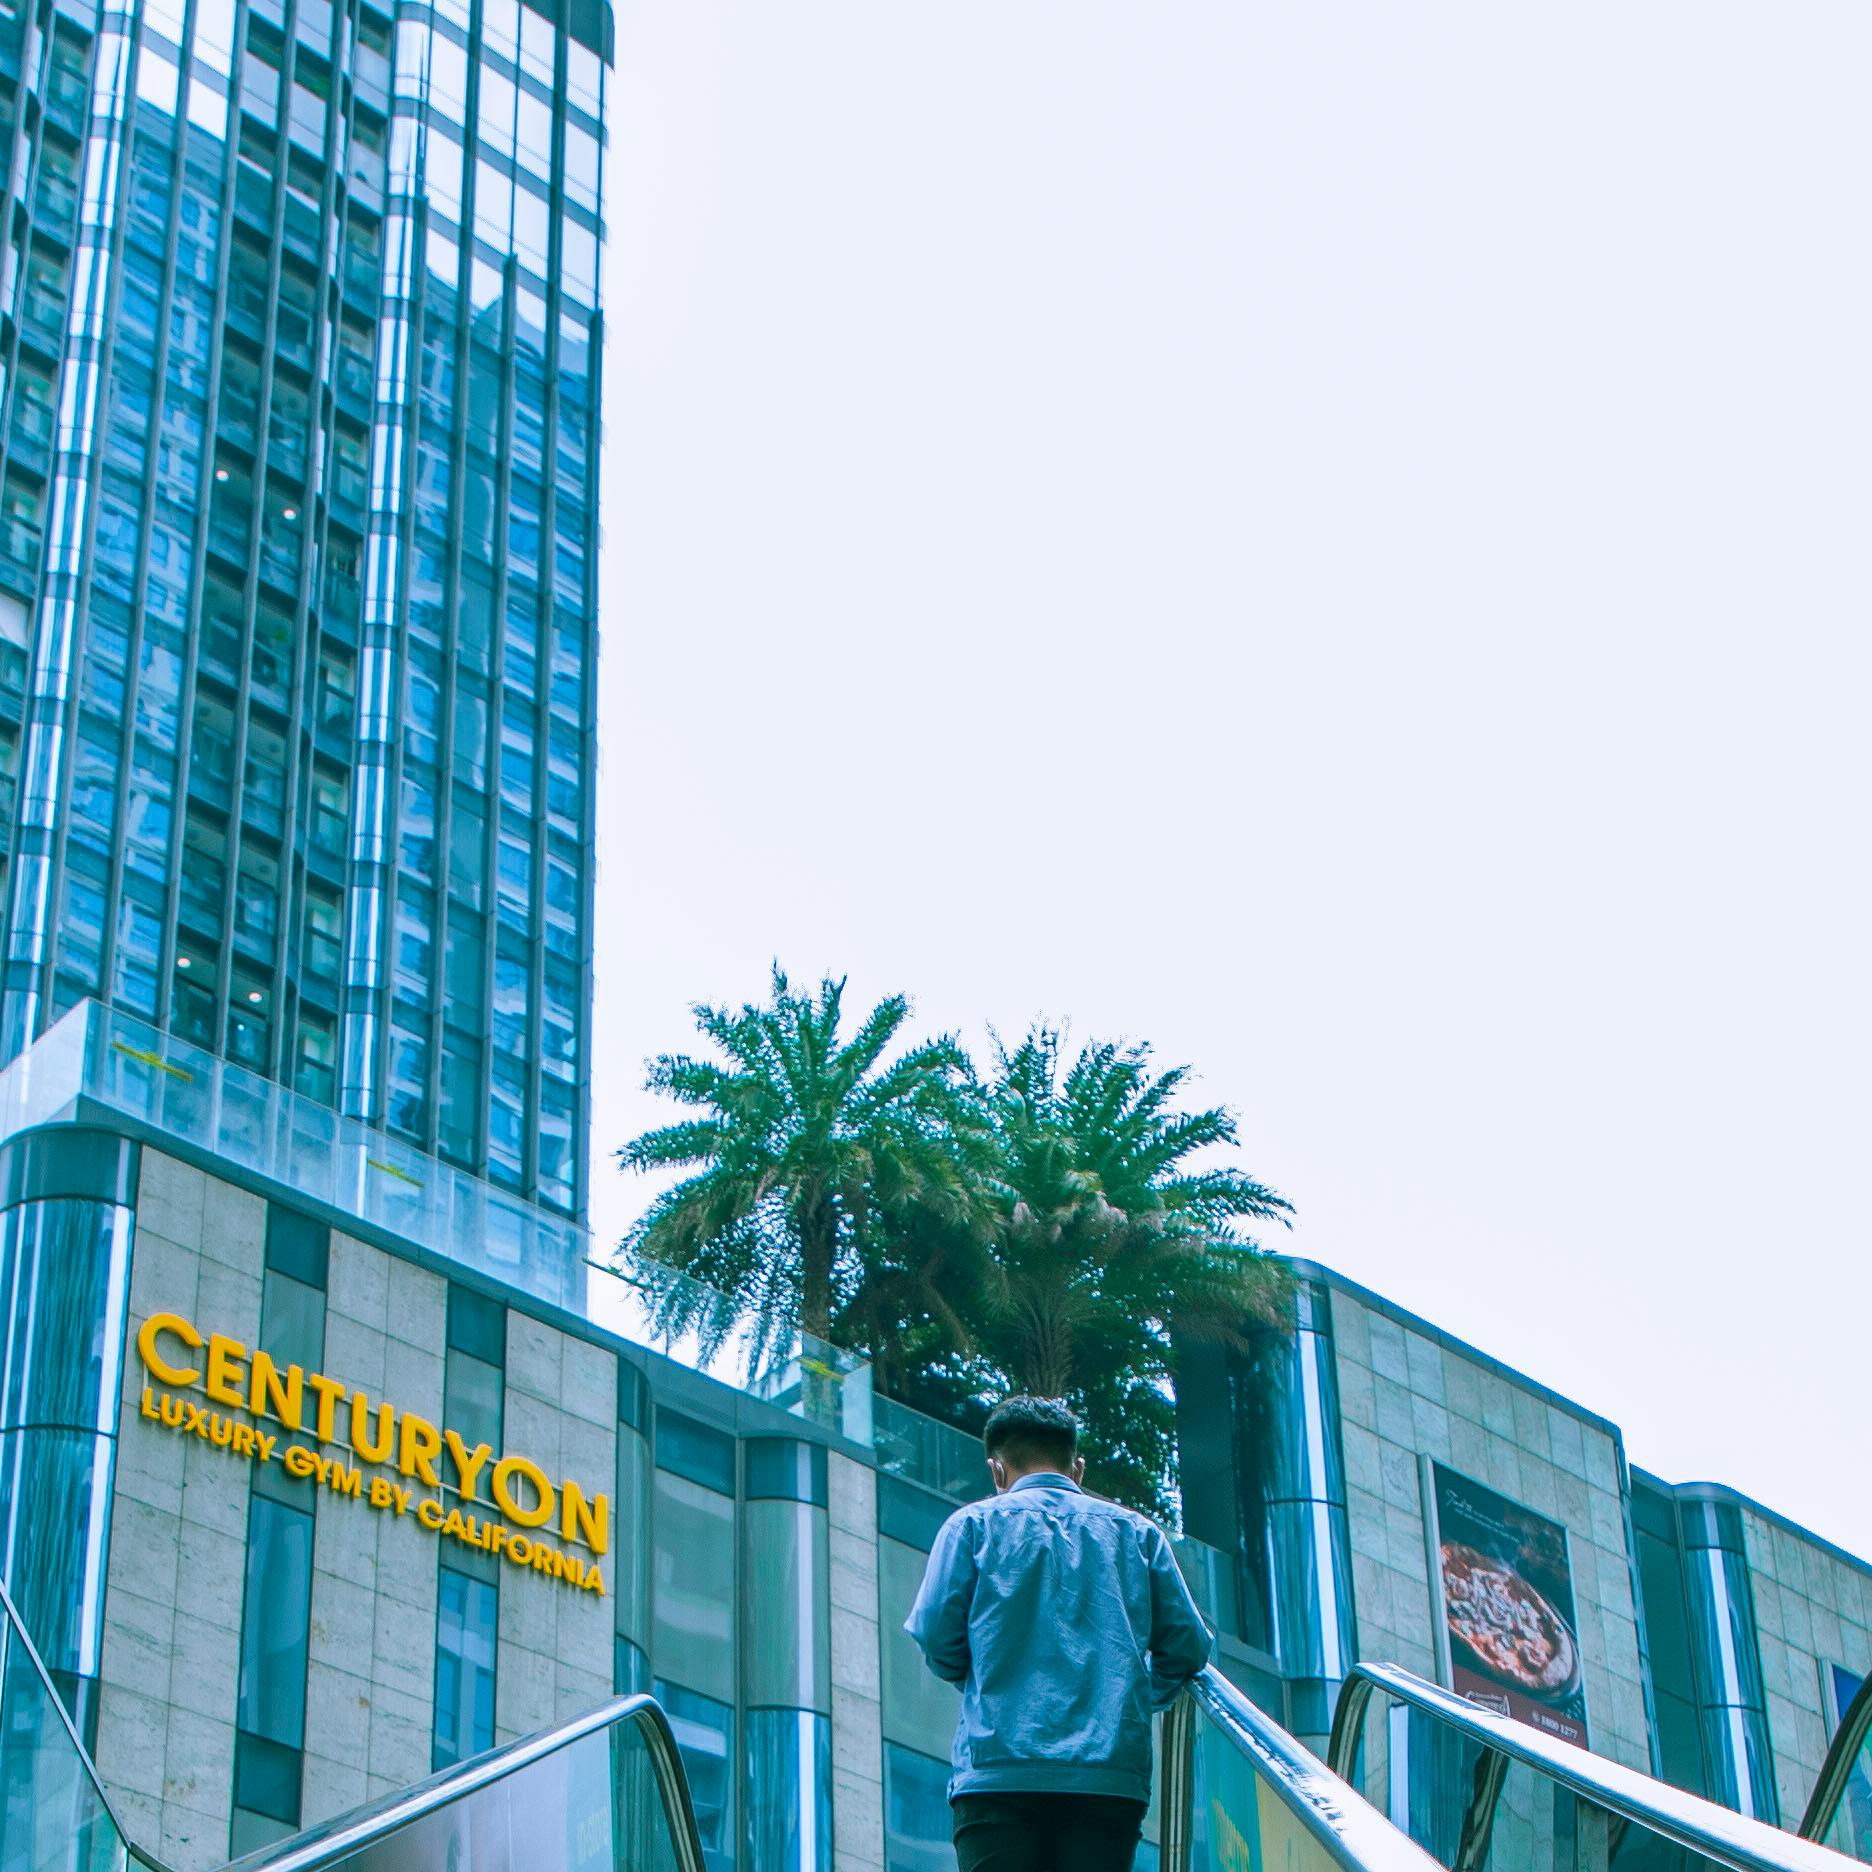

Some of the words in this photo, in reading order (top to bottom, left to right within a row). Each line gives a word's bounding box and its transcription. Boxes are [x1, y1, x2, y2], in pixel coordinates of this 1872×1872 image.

[139, 1313, 608, 1555] CENTURYON
[141, 1387, 276, 1461] LUXURY
[285, 1445, 361, 1498] GYM
[370, 1476, 415, 1516] BY
[418, 1499, 605, 1595] CALIFORNIA
